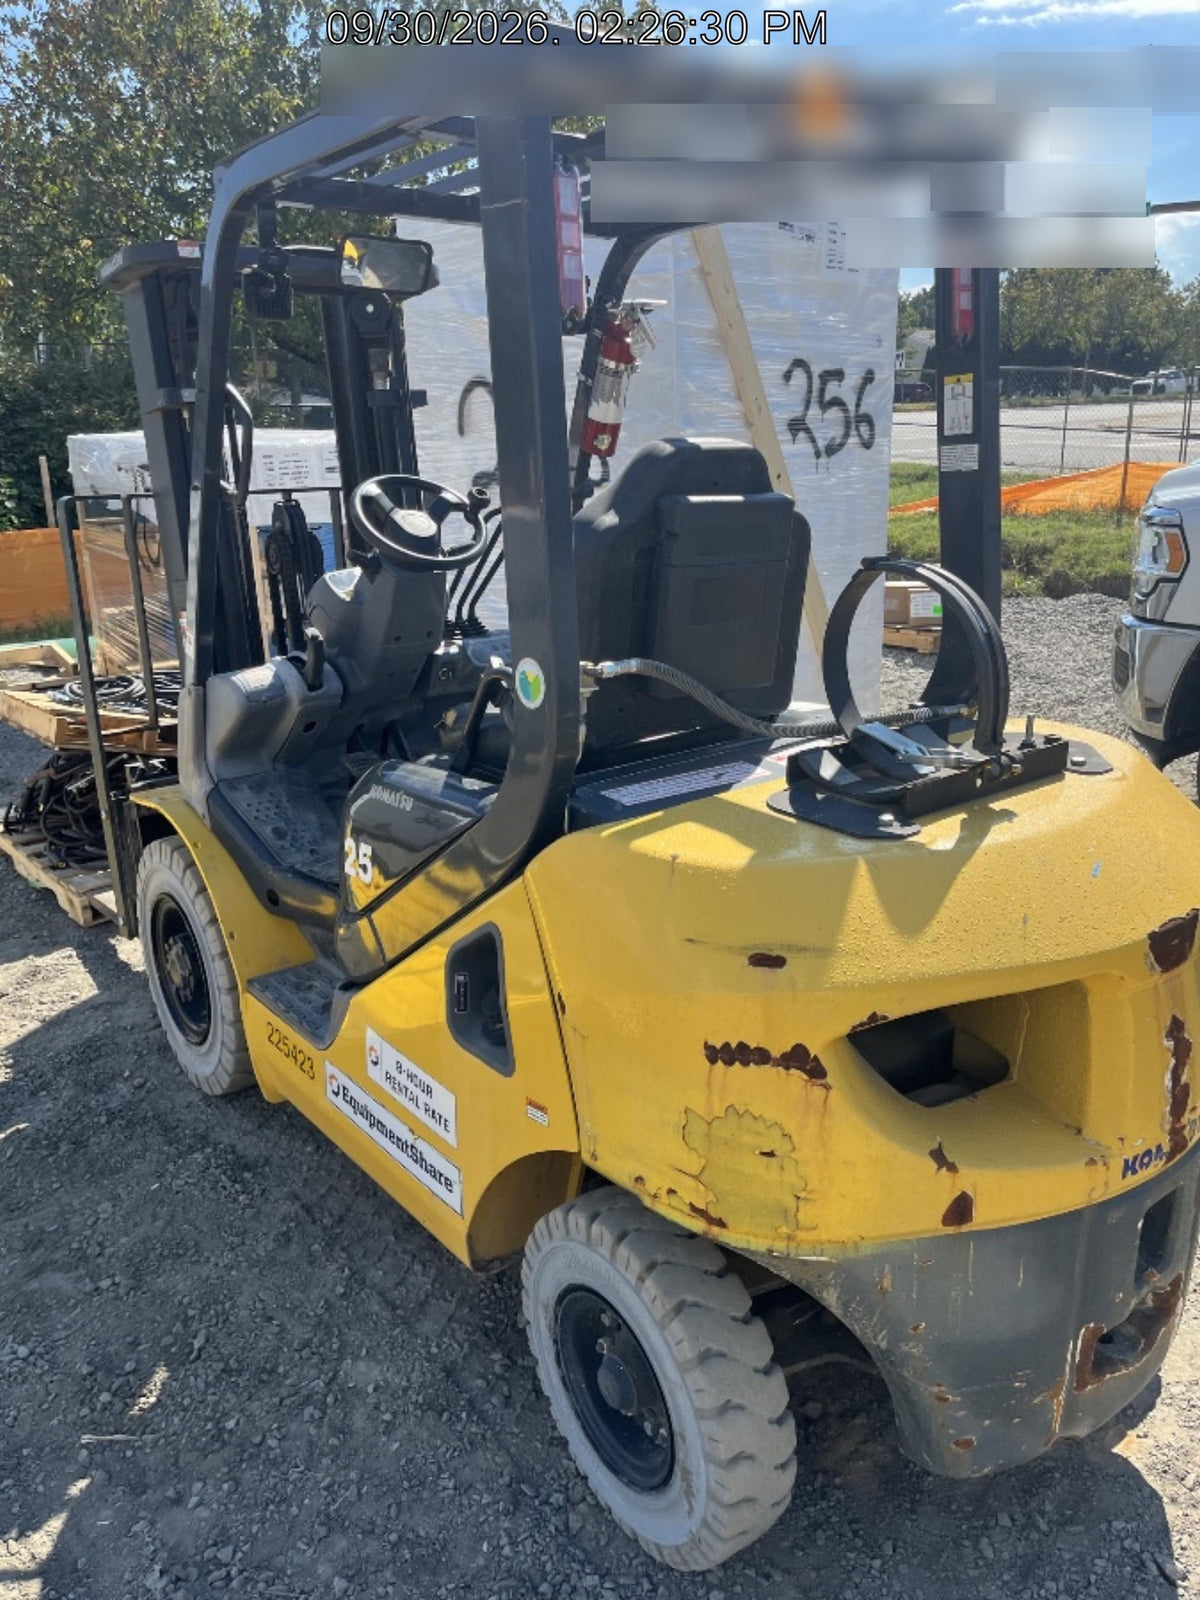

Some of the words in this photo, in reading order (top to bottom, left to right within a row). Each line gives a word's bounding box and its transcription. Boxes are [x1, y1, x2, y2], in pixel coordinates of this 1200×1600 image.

[783, 358, 875, 459] 256
[344, 837, 372, 884] 25
[266, 1021, 315, 1080] 225423
[396, 1060, 433, 1099] 8-HOUR
[385, 1070, 420, 1110] RENTAL
[424, 1102, 450, 1133] RATE
[341, 1084, 454, 1194] EquipmentShare
